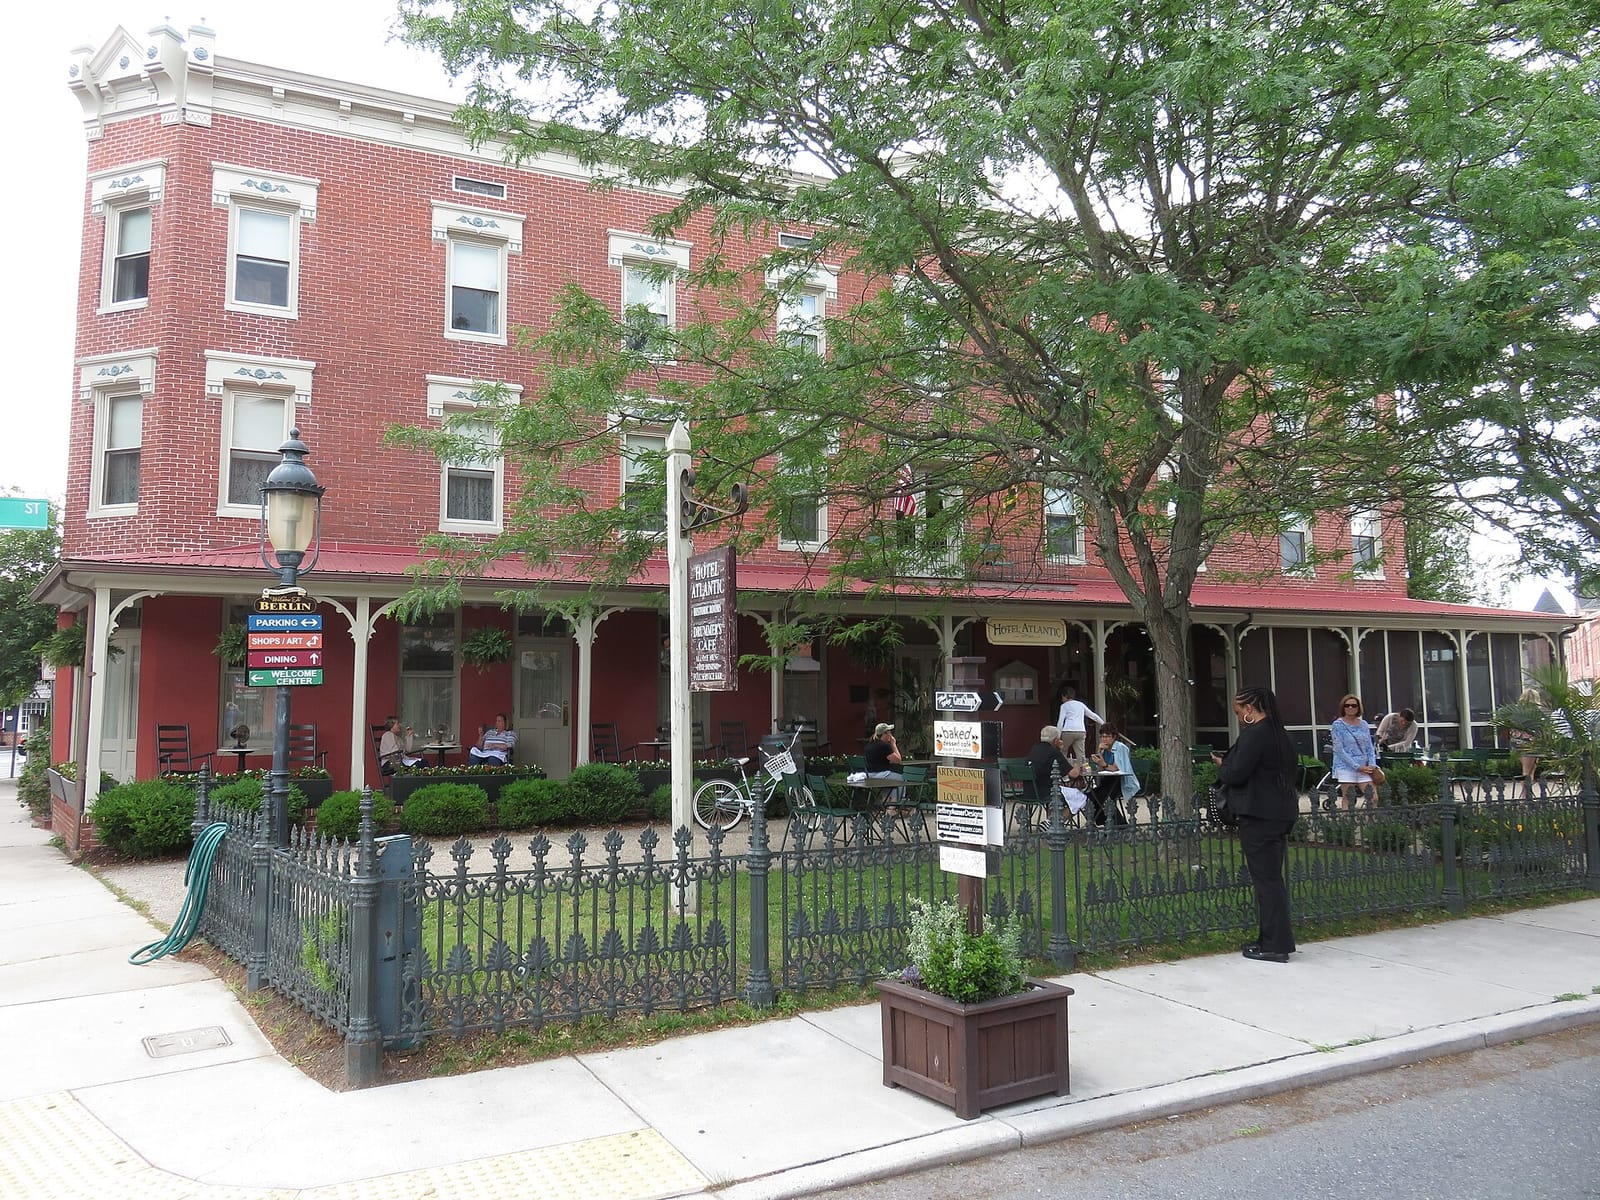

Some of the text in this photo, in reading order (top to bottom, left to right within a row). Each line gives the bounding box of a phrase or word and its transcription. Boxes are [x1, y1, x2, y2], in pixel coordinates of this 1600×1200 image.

[24, 502, 41, 515] ST
[695, 561, 719, 580] HOTEL
[691, 578, 725, 598] ATLANTIC
[259, 601, 311, 611] BERLIN
[256, 619, 298, 627] PARKING
[993, 623, 1061, 637] HOTEL ATLANTIC
[251, 637, 281, 645] SHOPS
[286, 637, 303, 645] ART
[264, 656, 297, 664] DINING
[271, 670, 317, 678] WELCOME
[276, 677, 313, 685] CENTER
[941, 726, 972, 740] baked
[938, 767, 984, 779] ARTS COUNCIL
[943, 792, 978, 804] LOCAL ART
